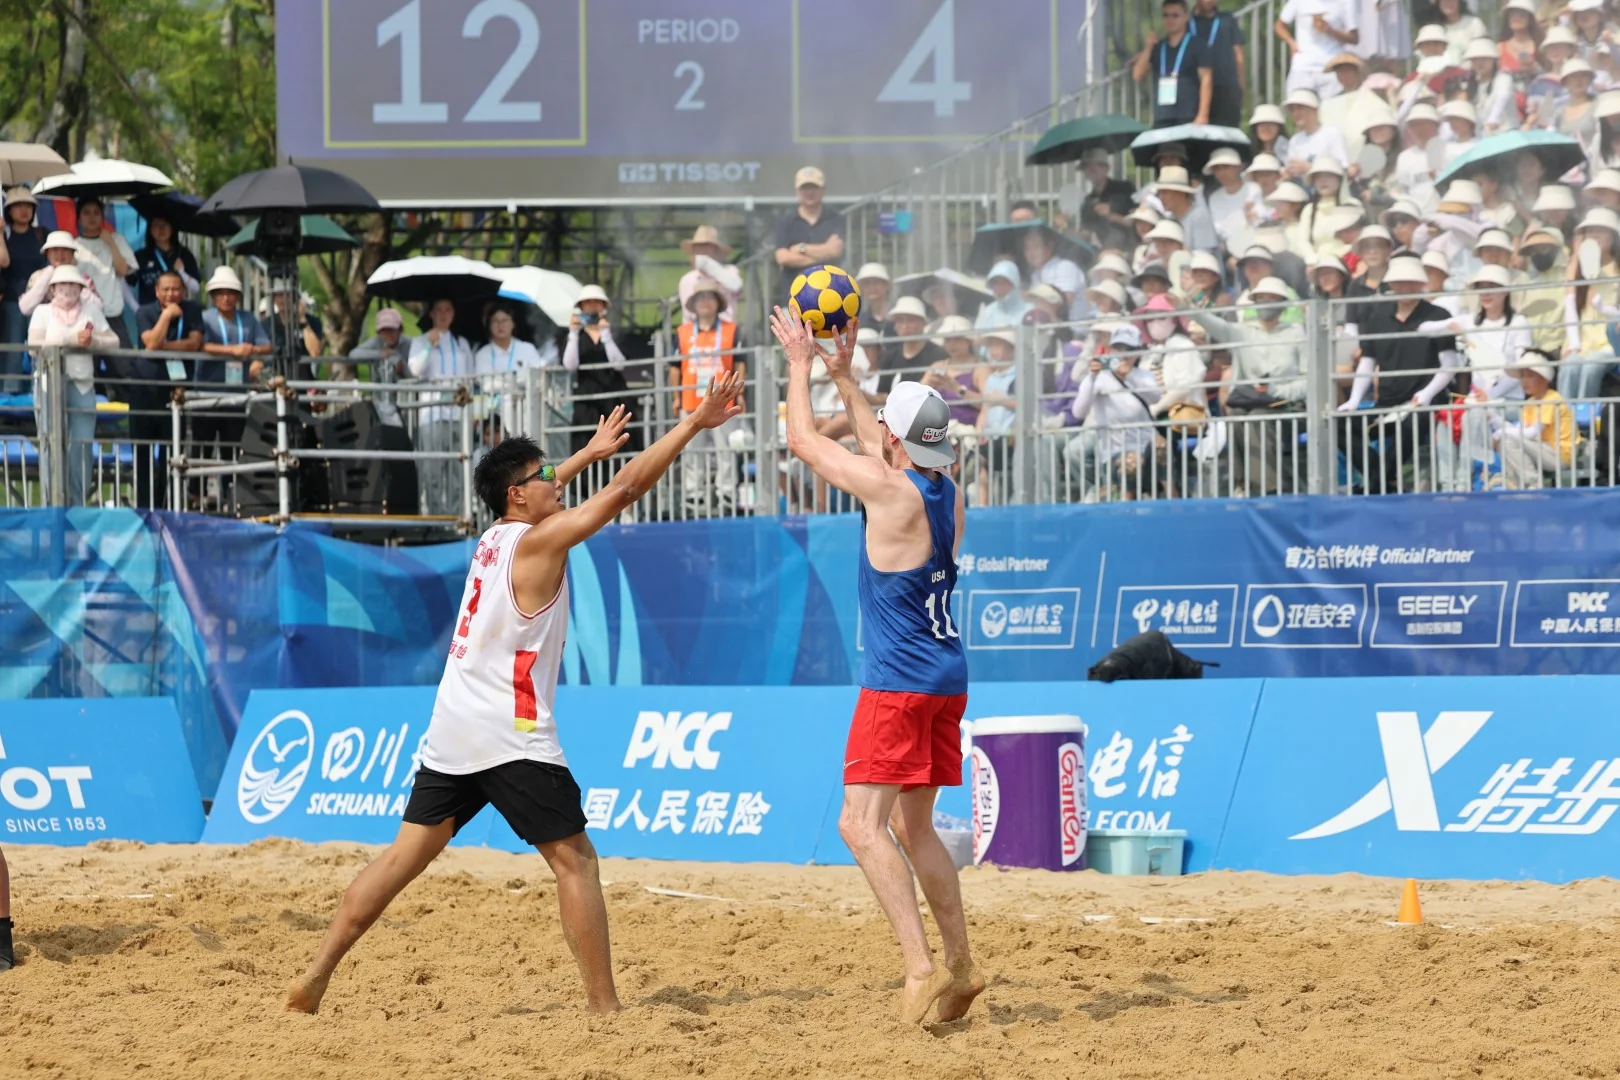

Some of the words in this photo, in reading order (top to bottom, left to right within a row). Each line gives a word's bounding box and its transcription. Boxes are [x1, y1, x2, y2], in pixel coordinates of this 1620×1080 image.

[638, 18, 740, 43] PERIOD
[373, 0, 542, 123] 12
[876, 0, 972, 117] 4
[673, 60, 706, 110] 2
[659, 162, 761, 182] TISSOT
[977, 557, 1007, 573] Global
[1008, 557, 1049, 572] Partner
[1285, 545, 1379, 569] 官方合作伙伴
[1380, 547, 1425, 565] Official
[1426, 548, 1474, 564] Partner
[932, 570, 945, 583] USA
[1161, 599, 1219, 625] 中国电信
[1398, 595, 1478, 615] GEELY
[1568, 592, 1610, 613] PICC
[1287, 603, 1357, 628] 亚信安全
[622, 710, 733, 770] PICC
[1083, 724, 1194, 800] 电信
[0, 766, 93, 811] OT
[1443, 757, 1620, 834] 特步
[306, 792, 391, 816] SICHUAN
[583, 787, 771, 836] 国人民保险
[5, 817, 61, 833] SINCE
[65, 816, 107, 832] 1853
[1086, 810, 1172, 831] ECOM
